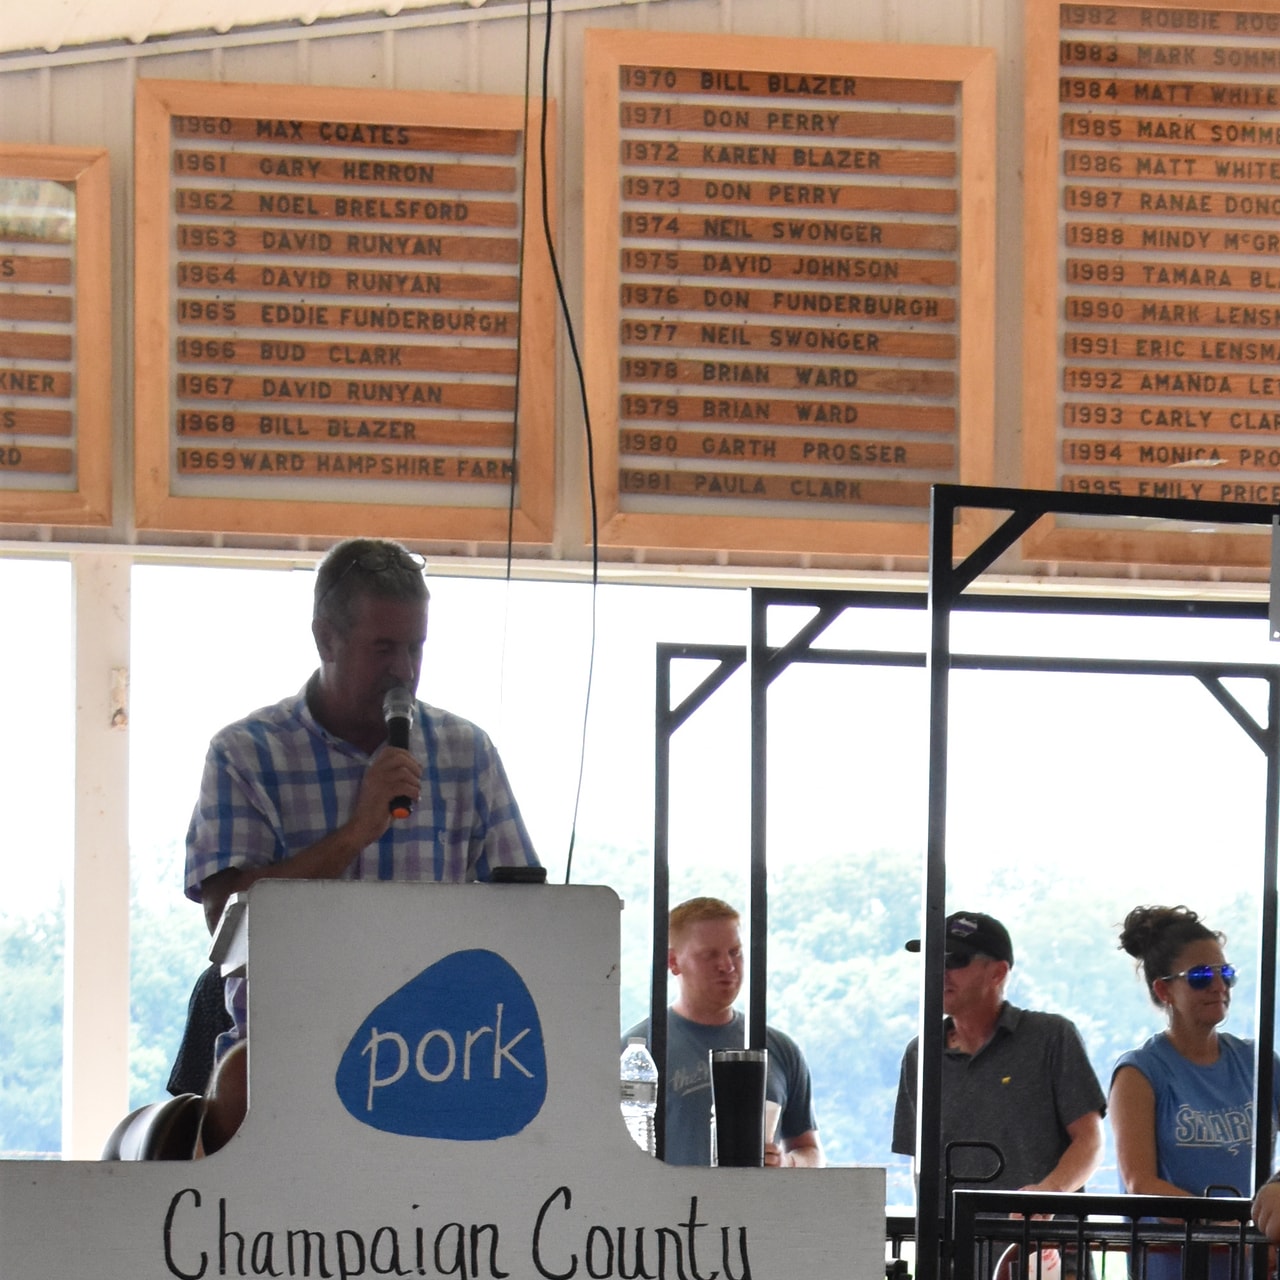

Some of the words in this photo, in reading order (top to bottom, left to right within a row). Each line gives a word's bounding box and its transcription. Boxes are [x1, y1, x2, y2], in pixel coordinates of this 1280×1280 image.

[622, 70, 677, 88] 1970
[700, 73, 751, 92] BILL
[768, 76, 857, 97] BLAZER
[1064, 81, 1119, 100] 1984
[1134, 83, 1195, 102] MATT
[1211, 85, 1279, 106] WHITE
[623, 106, 673, 125] 1971
[703, 109, 749, 129] DON
[767, 111, 840, 132] PERRY
[1068, 118, 1123, 138] 1985
[1137, 121, 1197, 141] MARK
[623, 144, 679, 162] 1972
[703, 147, 777, 165] KAREN
[793, 150, 882, 170] BLAZER
[1069, 155, 1123, 174] 1986
[1136, 158, 1197, 177] MATT
[179, 192, 236, 213] 1962
[259, 195, 320, 217] NOEL
[335, 198, 469, 222] BRELSFORD
[1069, 190, 1123, 209] 1987
[1139, 193, 1213, 214] RANAE
[625, 216, 681, 234] 1974
[704, 219, 753, 238] NEIL
[772, 221, 883, 243] SWONGER
[1070, 226, 1125, 245] 1988
[1142, 229, 1212, 249] MINDY
[180, 229, 236, 248] 1963
[262, 232, 332, 253] DAVID
[346, 234, 443, 257] RUNYAN
[623, 252, 680, 271] 1975
[703, 254, 773, 274] DAVID
[792, 257, 899, 279] JOHNSON
[1071, 263, 1125, 283] 1989
[1143, 266, 1232, 288] TAMARA
[179, 265, 236, 286] 1964
[262, 268, 332, 289] DAVID
[346, 271, 442, 294] RUNYAN
[623, 288, 680, 306] 1976
[703, 290, 751, 310] DON
[772, 293, 939, 318] FUNDERBURGH
[1071, 301, 1125, 321] 1990
[1142, 303, 1202, 324] MARK
[179, 302, 237, 323] 1965
[261, 305, 329, 327] EDDIE
[339, 307, 508, 333] FUNDERBURGH
[623, 324, 678, 342] 1977
[701, 326, 751, 346] NEIL
[770, 329, 880, 351] SWONGER
[1070, 337, 1120, 356] 1991
[1135, 339, 1186, 359] ERIC
[179, 340, 236, 361] 1966
[260, 343, 306, 363] BUD
[328, 345, 402, 367] CLARK
[180, 377, 234, 396] 1967
[262, 380, 332, 400] DAVID
[346, 382, 443, 404] RUNYAN
[1069, 371, 1123, 389] 1992
[1139, 373, 1232, 394] AMANDA
[624, 399, 679, 417] 1979
[702, 401, 770, 420] BRIAN
[795, 404, 860, 424] WARD
[1069, 406, 1123, 425] 1993
[1139, 408, 1212, 429] CARLY
[1069, 443, 1123, 461] 1994
[1139, 445, 1222, 465] MONICA
[361, 1003, 535, 1111] pork
